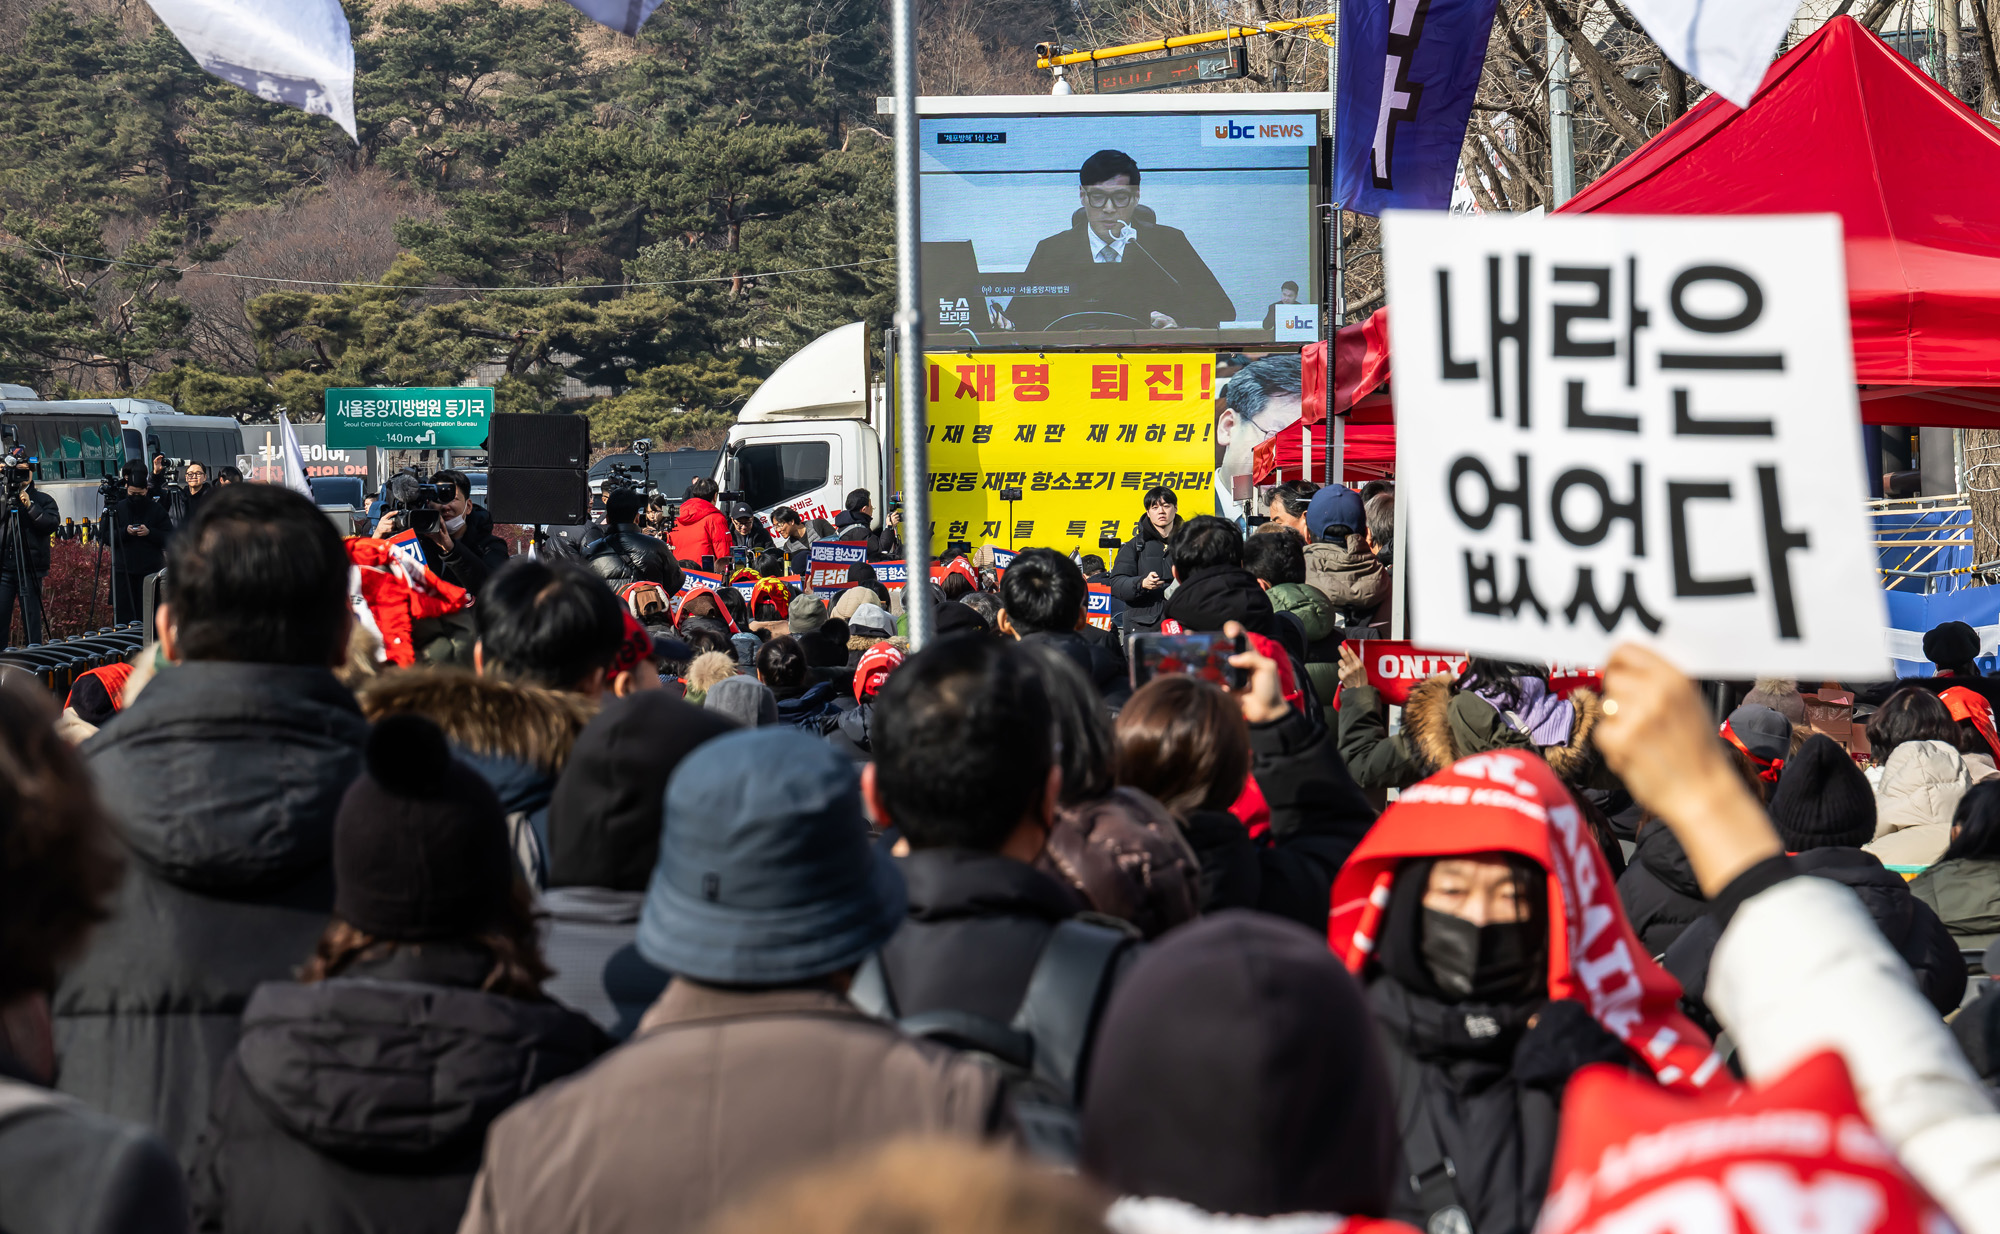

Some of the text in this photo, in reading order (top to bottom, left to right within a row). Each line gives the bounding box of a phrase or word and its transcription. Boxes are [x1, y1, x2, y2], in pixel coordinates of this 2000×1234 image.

[1215, 120, 1304, 139] ubc NEWS
[1003, 285, 1016, 294] 시각
[1019, 285, 1071, 294] 서울중앙지방법원
[939, 298, 970, 311] 뉴스
[939, 312, 970, 322] 브리핑
[1285, 316, 1314, 330] ubc
[1433, 251, 1788, 440] 내란은
[1090, 363, 1211, 402] 퇴진!
[336, 399, 485, 418] 서울중앙지방법원 등기국
[421, 421, 456, 429] Registration
[1014, 424, 1066, 443] 재판
[1086, 423, 1212, 443] 재개하라!
[386, 433, 414, 443] 140m
[981, 472, 1026, 492] 재판
[1030, 471, 1116, 491] 항소포기
[1120, 471, 1213, 491] 특검하라!
[929, 520, 1035, 539] 현지를
[812, 546, 866, 563] 대장동 항소포기
[1445, 450, 1813, 645] 없었다
